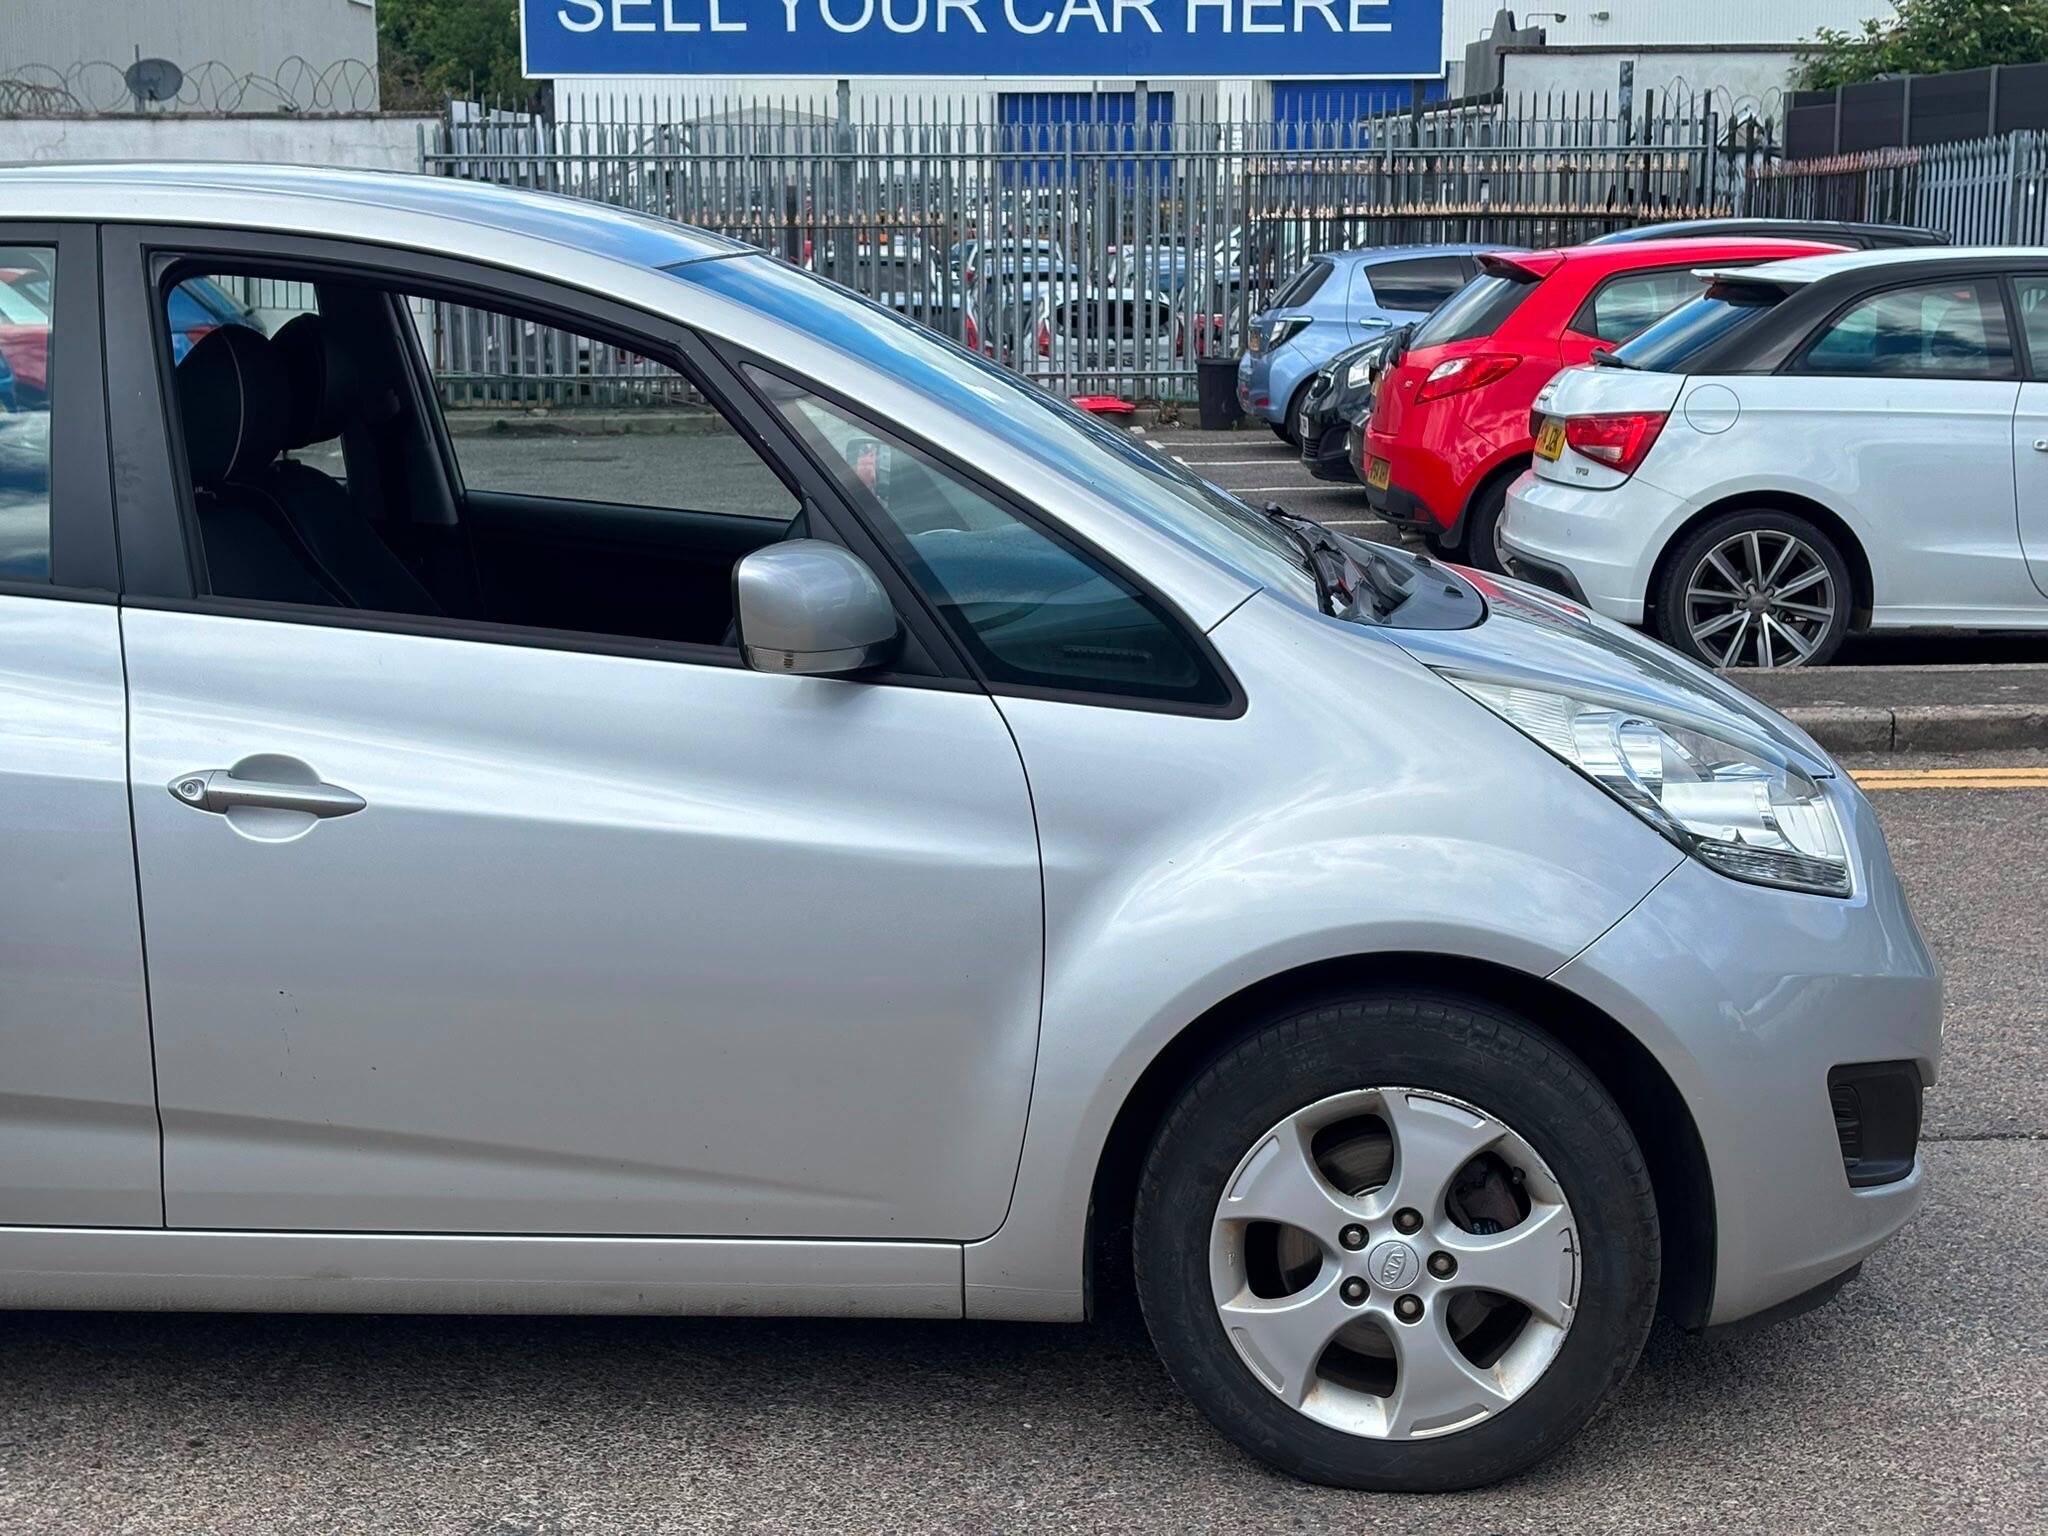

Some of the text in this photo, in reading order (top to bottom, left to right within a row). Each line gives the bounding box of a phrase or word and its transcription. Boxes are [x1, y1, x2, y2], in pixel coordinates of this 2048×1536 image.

[558, 0, 1392, 33] SELL YOUR CAR HERE
[1382, 1251, 1405, 1281] KIA
